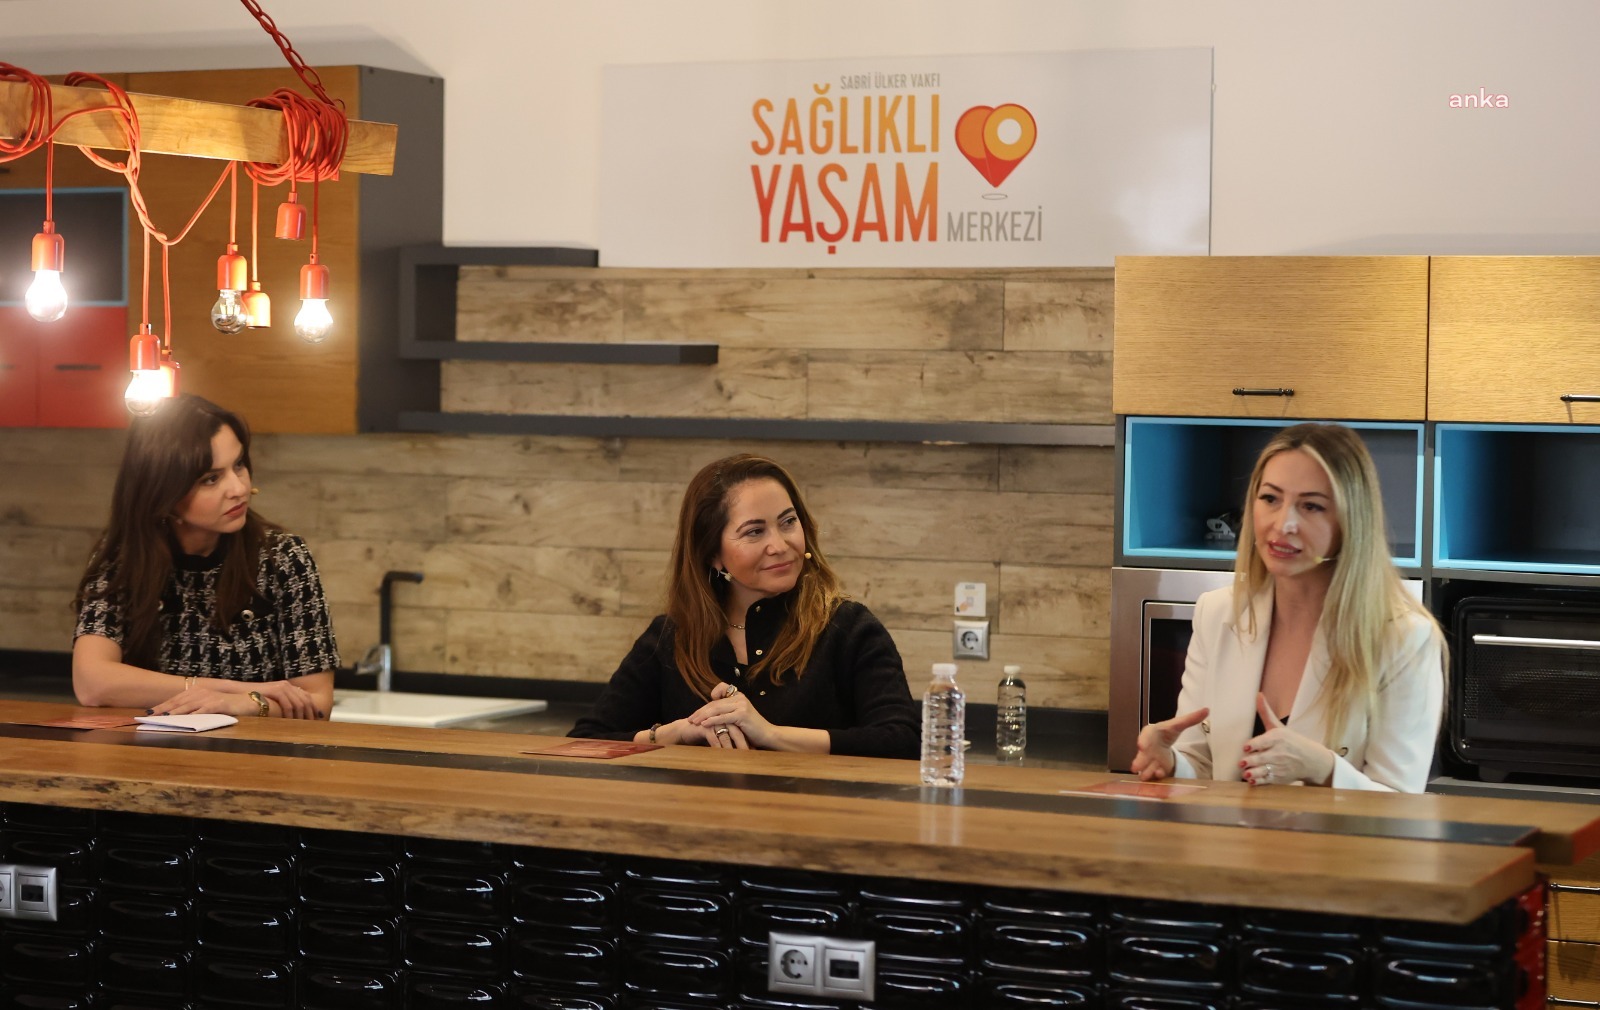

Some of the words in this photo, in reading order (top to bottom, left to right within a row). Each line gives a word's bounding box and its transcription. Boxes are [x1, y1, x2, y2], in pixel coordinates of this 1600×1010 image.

[840, 72, 871, 90] SABRİ
[874, 72, 907, 89] ÜLKER
[911, 72, 940, 88] VAKFI
[751, 83, 940, 156] SAĞLIKLI
[750, 161, 939, 254] YAŞAM
[947, 205, 1042, 242] MERKEZİ
